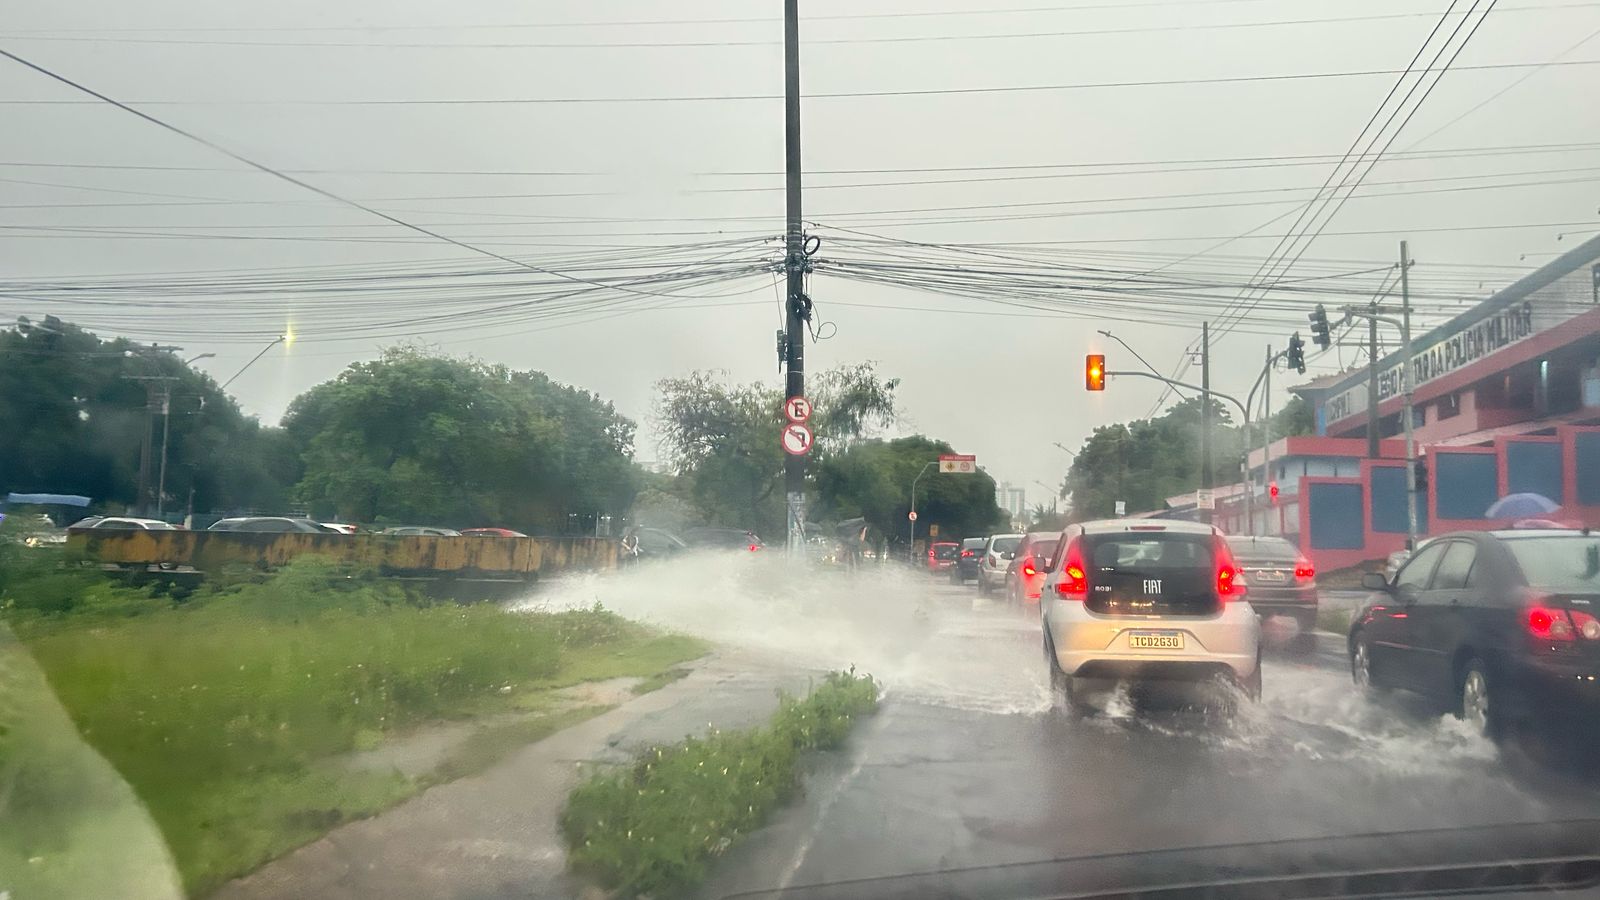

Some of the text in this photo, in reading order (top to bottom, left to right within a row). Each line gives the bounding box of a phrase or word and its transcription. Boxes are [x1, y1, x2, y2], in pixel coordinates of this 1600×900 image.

[1486, 301, 1531, 352] MILITAR
[1143, 579, 1162, 594] FIAT
[1134, 636, 1179, 647] TCD2G30
